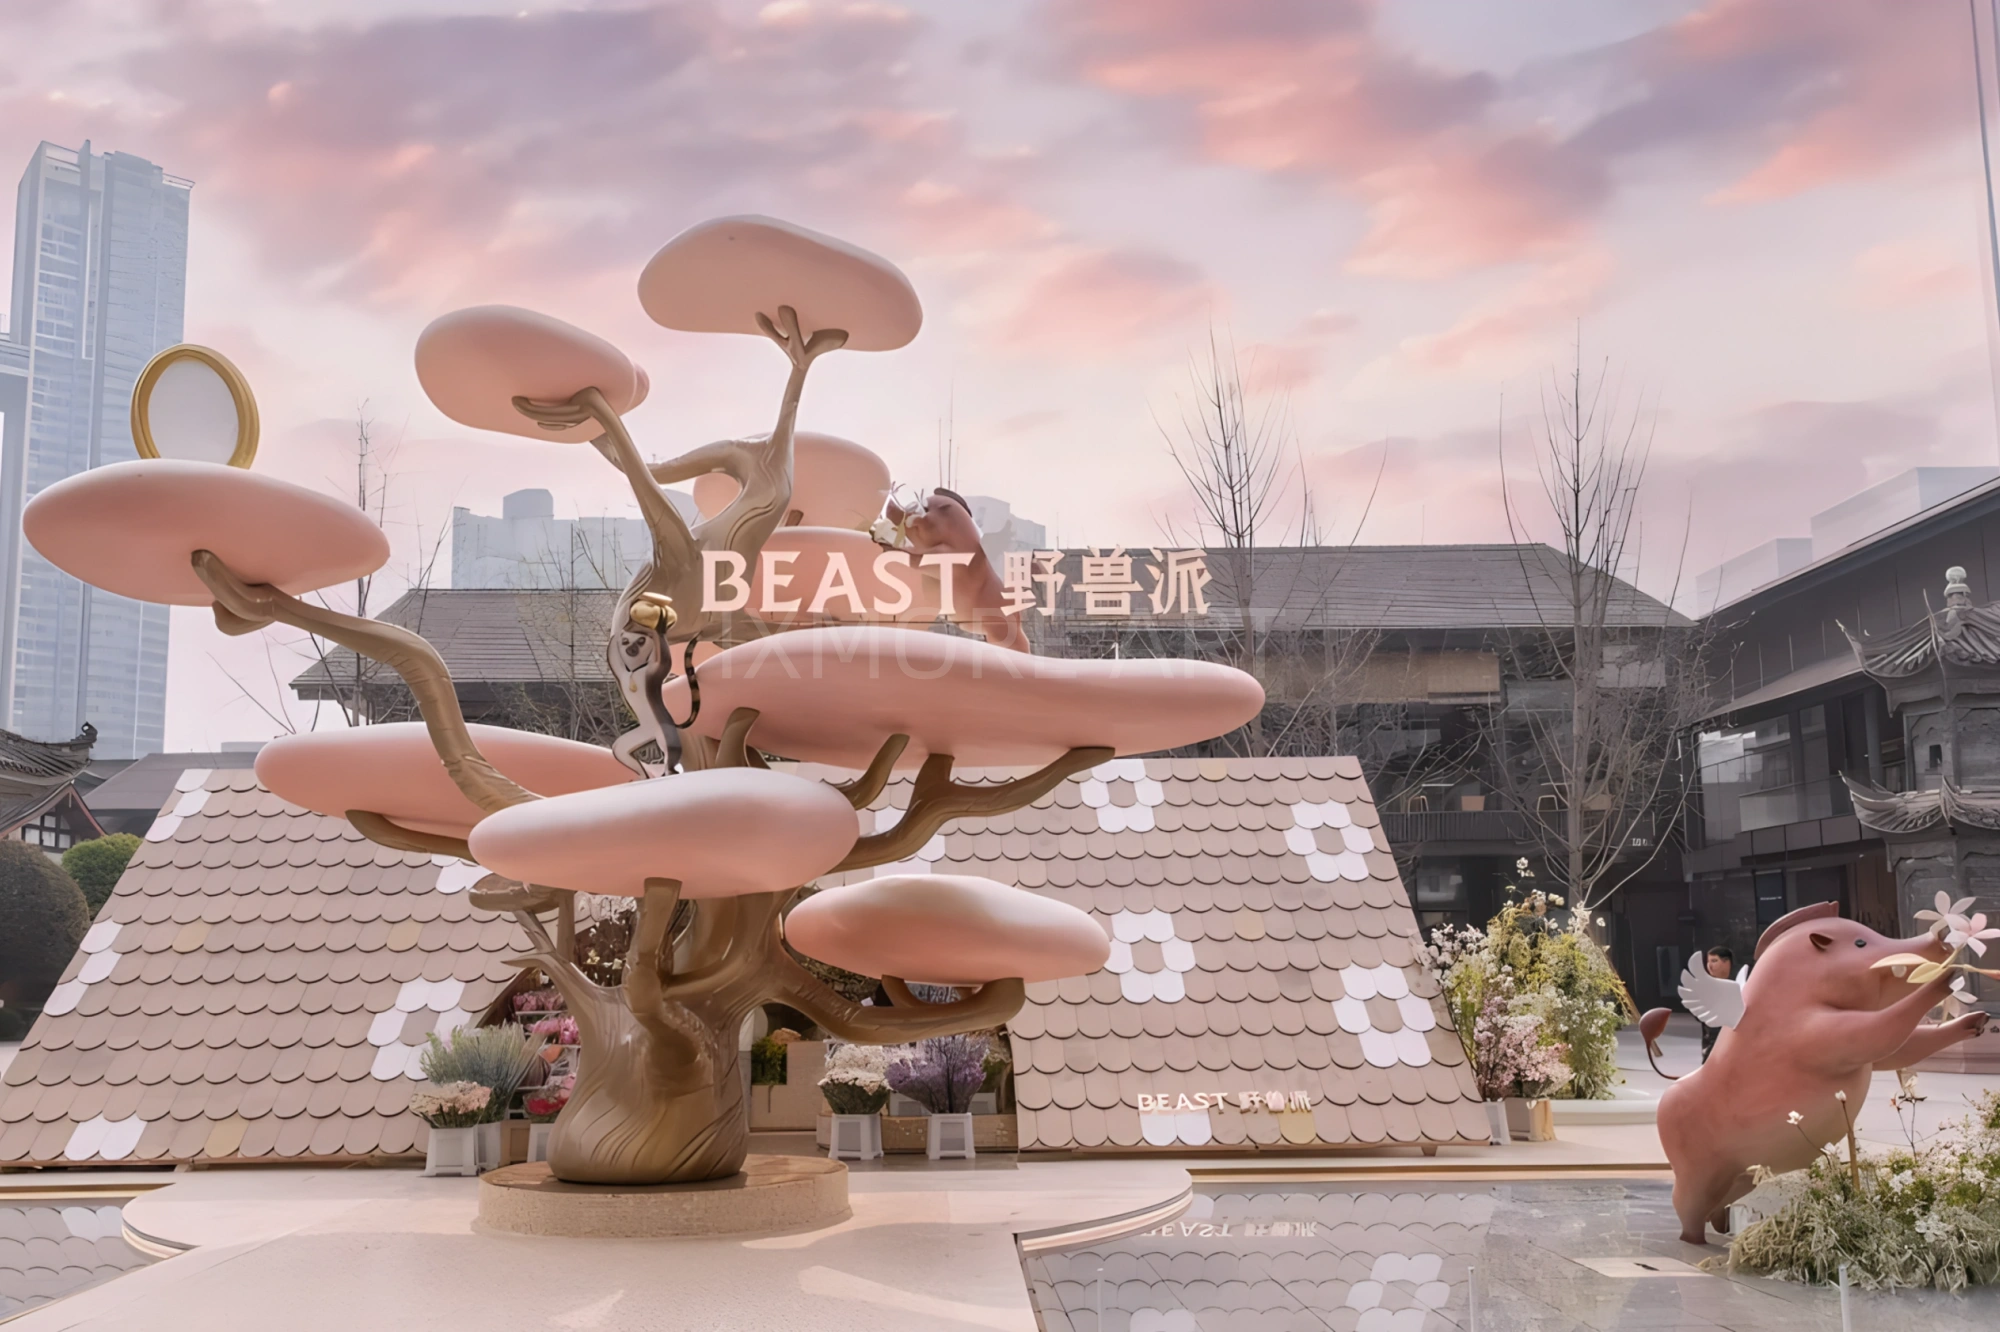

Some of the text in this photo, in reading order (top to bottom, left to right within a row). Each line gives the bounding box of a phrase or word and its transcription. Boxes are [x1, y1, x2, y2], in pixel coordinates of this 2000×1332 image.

[700, 545, 1213, 616] BEAST 野兽派
[1138, 1092, 1228, 1112] BEAST
